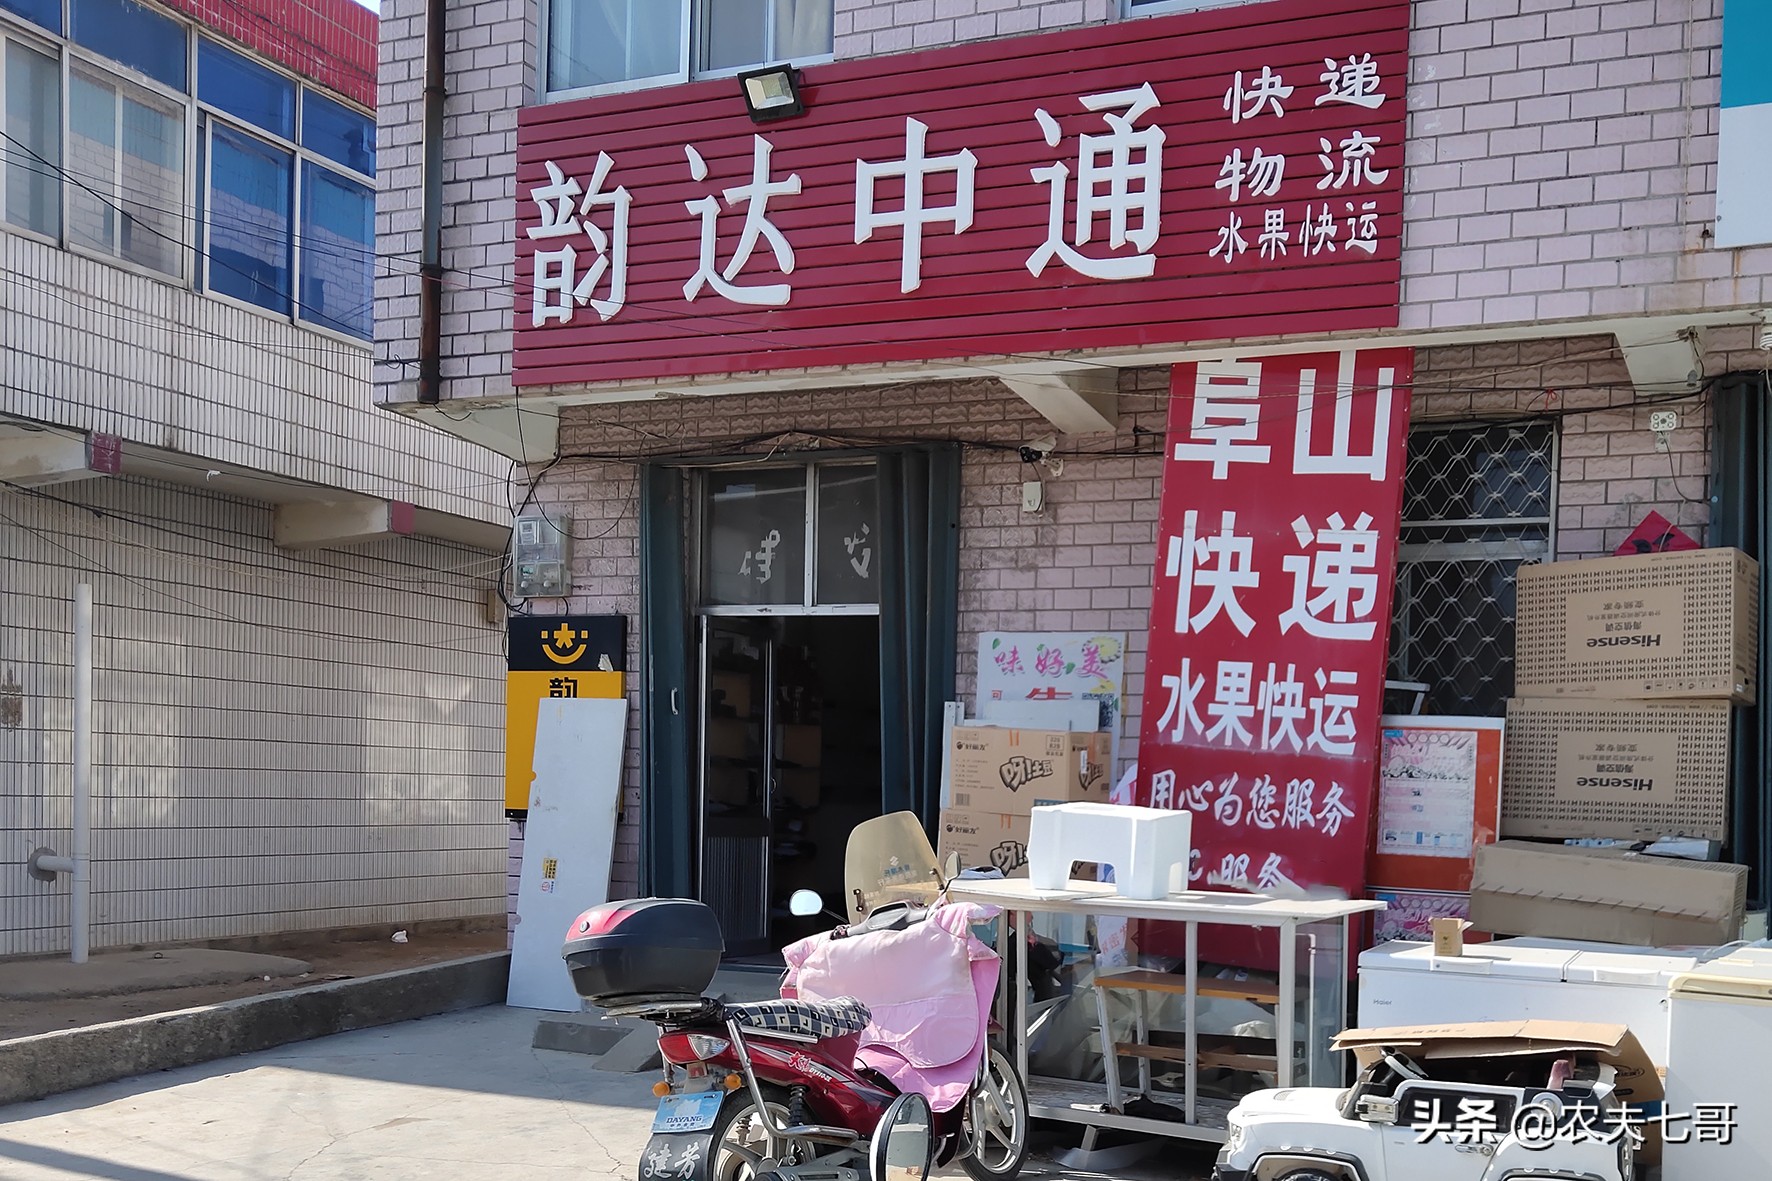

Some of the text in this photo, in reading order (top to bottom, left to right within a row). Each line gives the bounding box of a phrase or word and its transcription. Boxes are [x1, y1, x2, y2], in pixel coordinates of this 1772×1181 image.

[1223, 53, 1387, 124] 快递
[1215, 131, 1389, 202] 物流
[526, 81, 1167, 328] 韵达中通
[1209, 201, 1379, 264] 水果快运
[1174, 350, 1395, 481] 阜山
[1165, 510, 1379, 641] 快递
[994, 645, 1108, 679] 味好美
[1586, 633, 1661, 648] Hisense
[1157, 657, 1359, 755] 水果快运
[1150, 769, 1355, 838] 用心为您服务
[1577, 776, 1653, 791] Hisense
[666, 1115, 702, 1123] DAYANG
